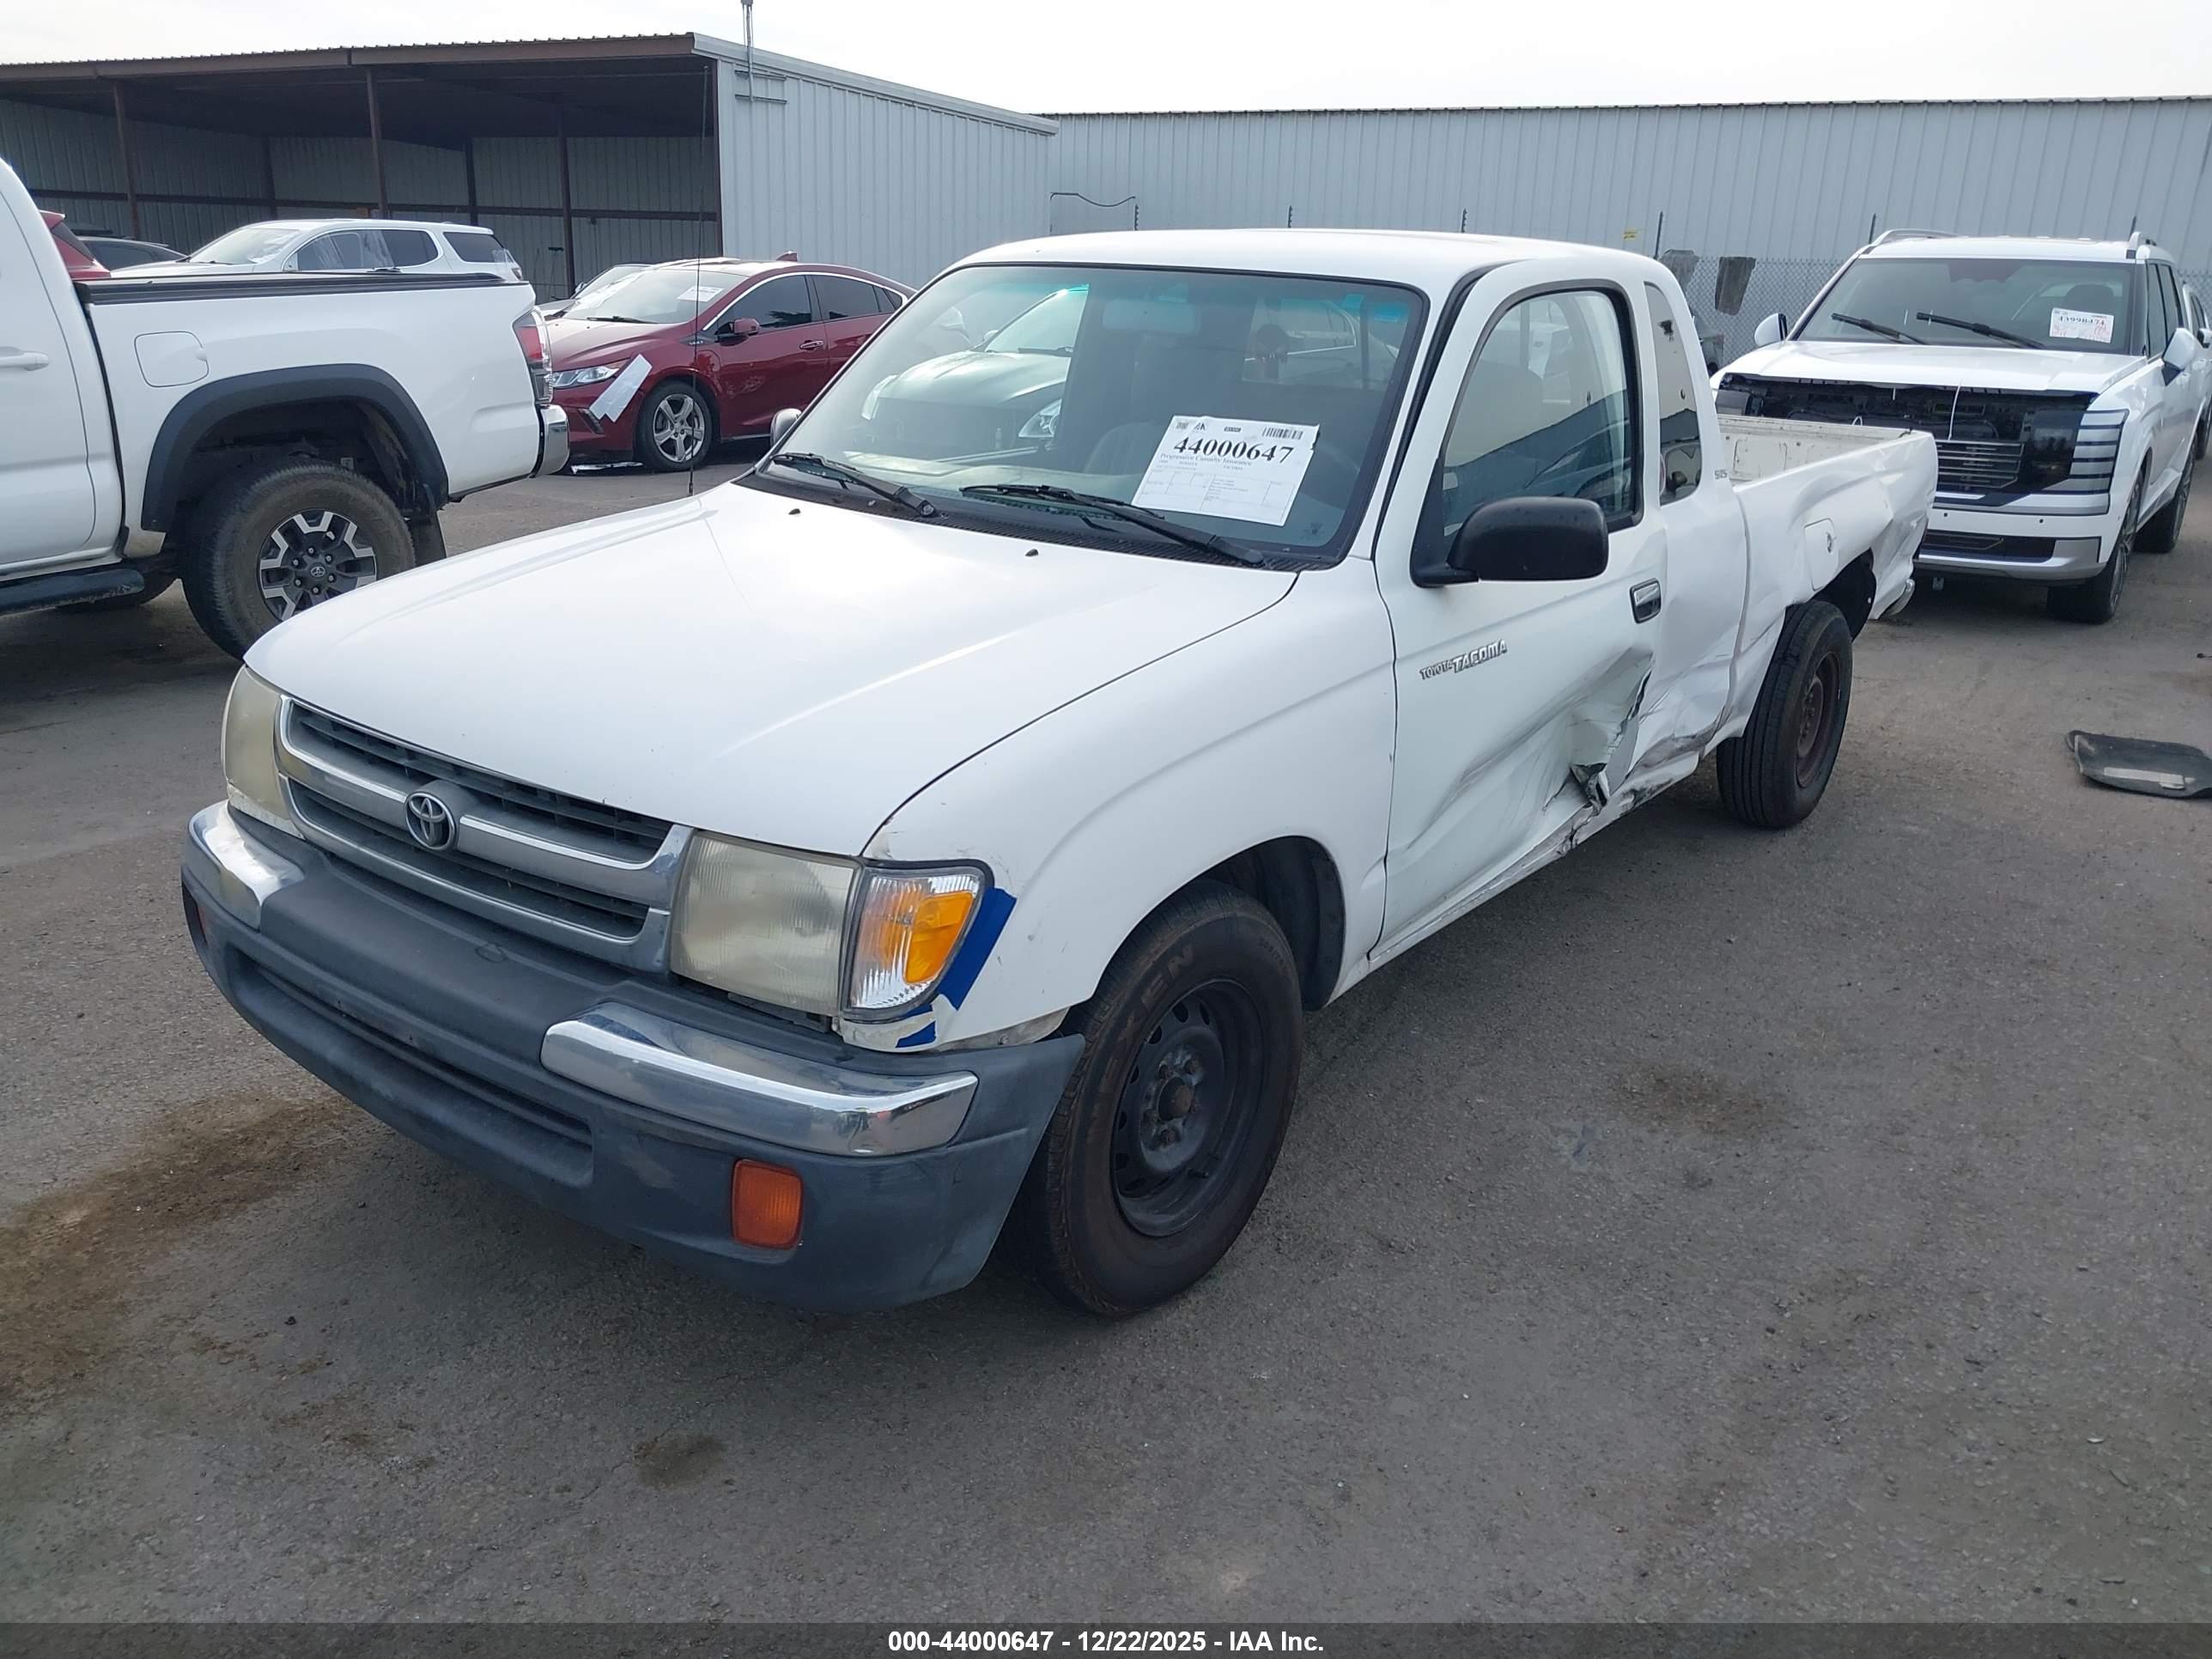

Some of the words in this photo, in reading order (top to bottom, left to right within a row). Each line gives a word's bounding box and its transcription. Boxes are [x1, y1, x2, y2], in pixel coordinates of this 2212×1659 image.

[1174, 436, 1295, 463] 44000647
[1419, 659, 1453, 680] TOYOTA
[1453, 639, 1508, 673] TACOMA
